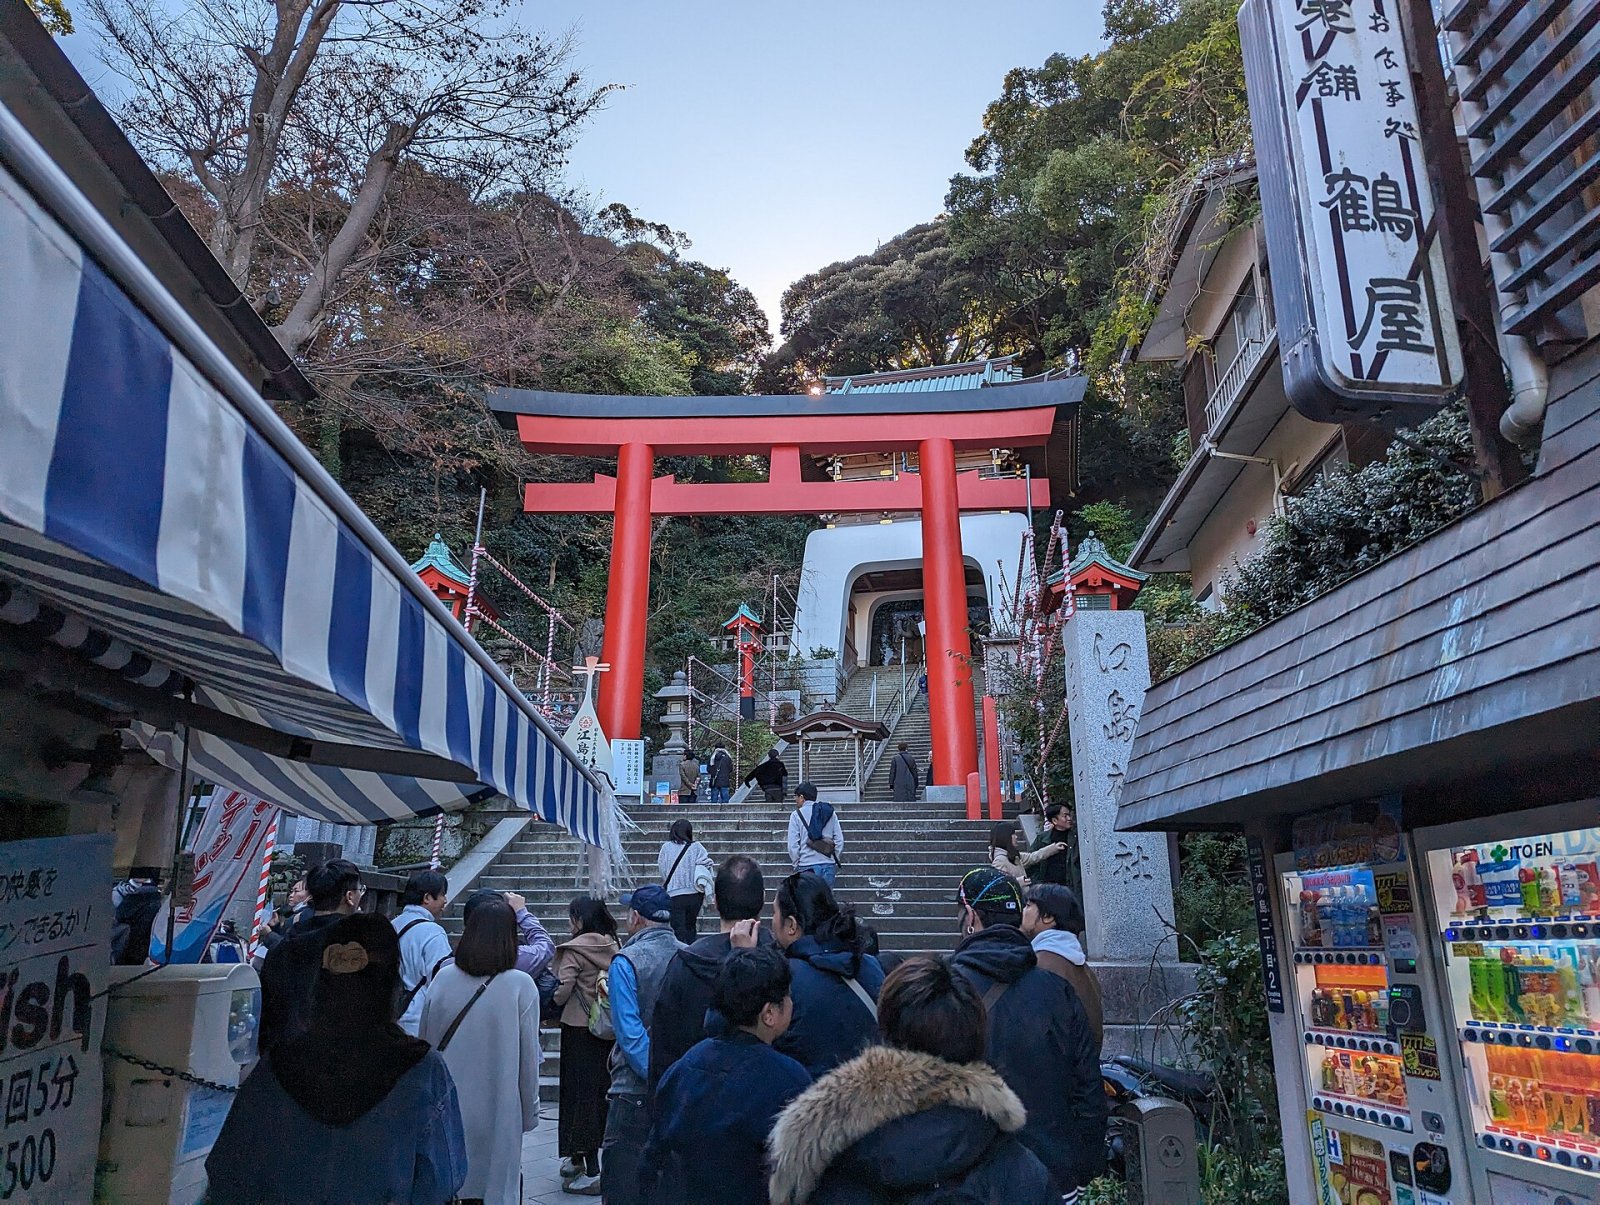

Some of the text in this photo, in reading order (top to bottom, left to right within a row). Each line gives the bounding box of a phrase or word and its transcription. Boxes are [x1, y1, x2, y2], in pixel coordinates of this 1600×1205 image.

[1368, 13, 1418, 141] お食事処
[1319, 167, 1435, 355] 鶴屋
[1510, 844, 1533, 859] ITO
[1535, 841, 1553, 856] EN
[0, 955, 92, 1054] ish
[0, 1053, 80, 1128] 回5分
